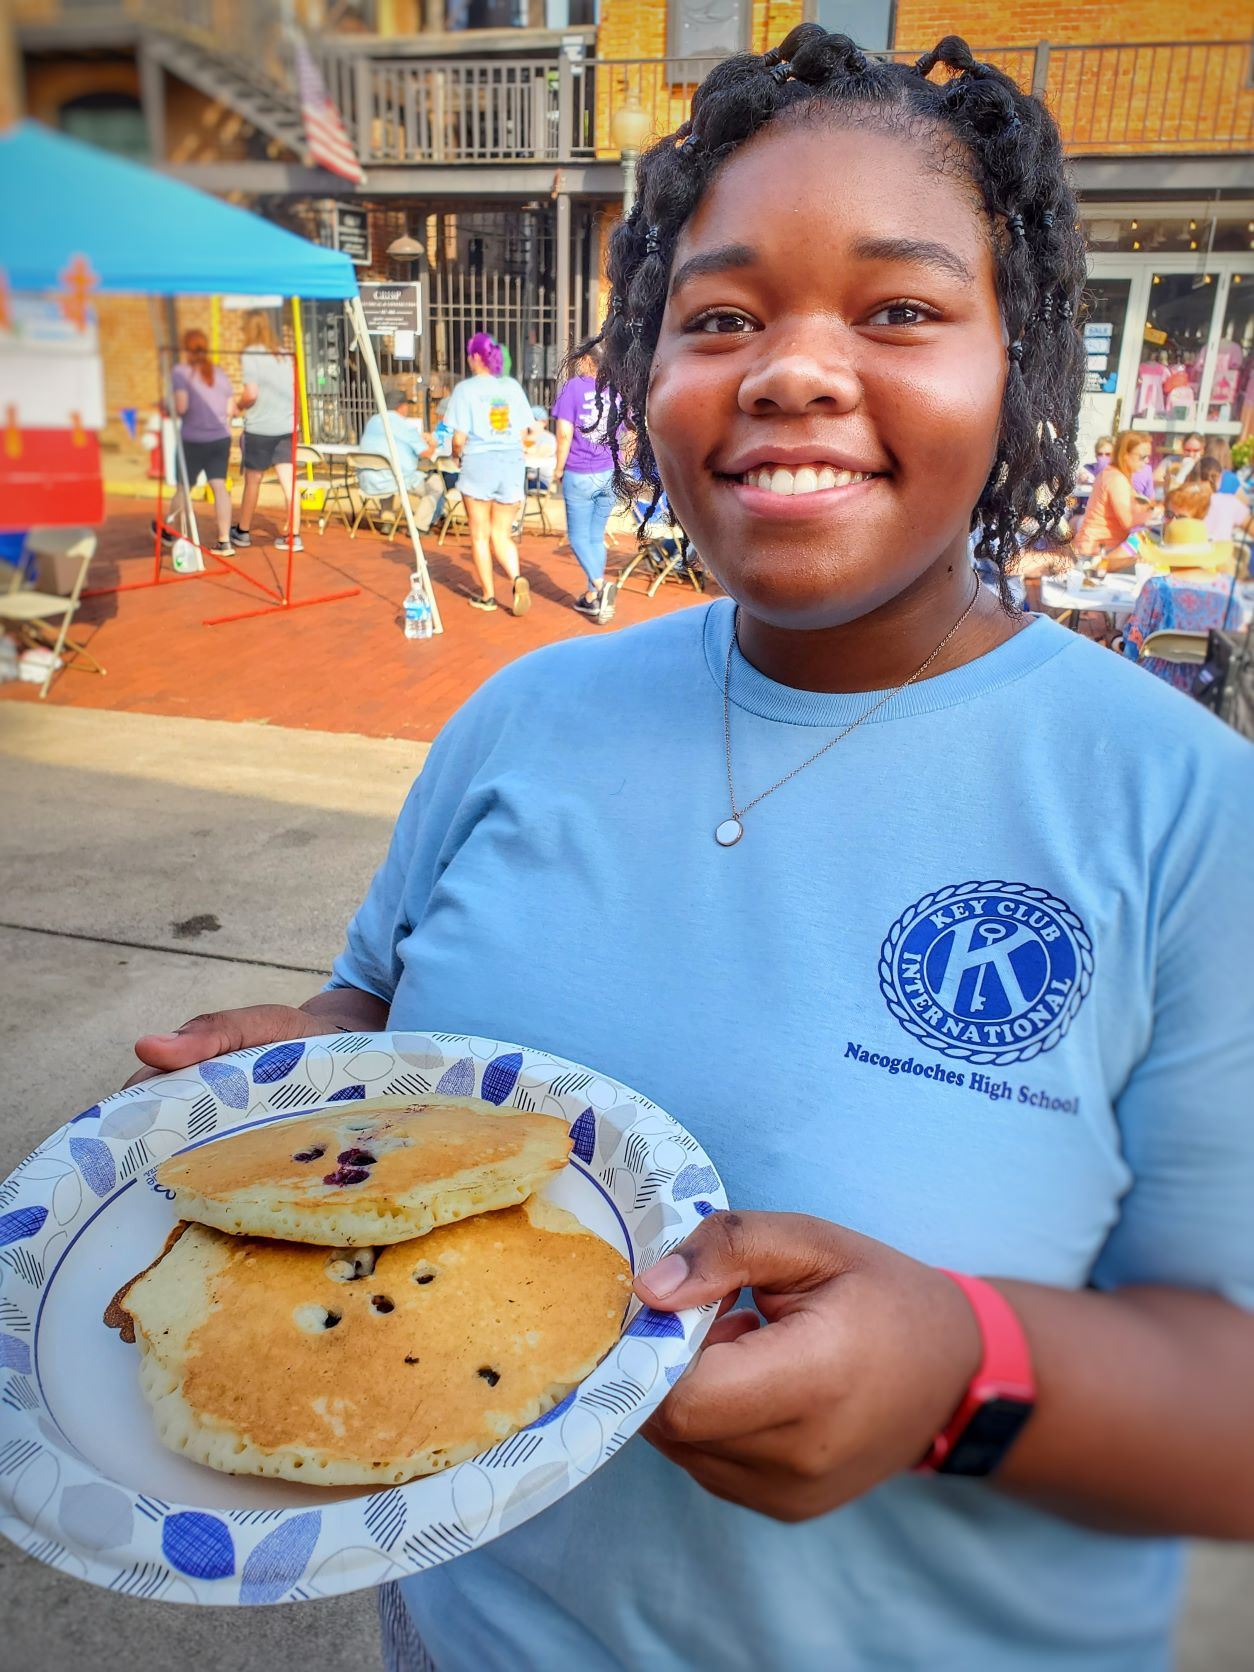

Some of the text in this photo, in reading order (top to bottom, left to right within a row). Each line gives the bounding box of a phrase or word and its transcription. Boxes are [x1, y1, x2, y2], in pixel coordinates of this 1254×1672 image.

[928, 899, 1061, 943] KEY CLUB
[902, 951, 1072, 1044] INTERNATIONAL
[844, 1042, 1080, 1115] Nacogdoches High School
